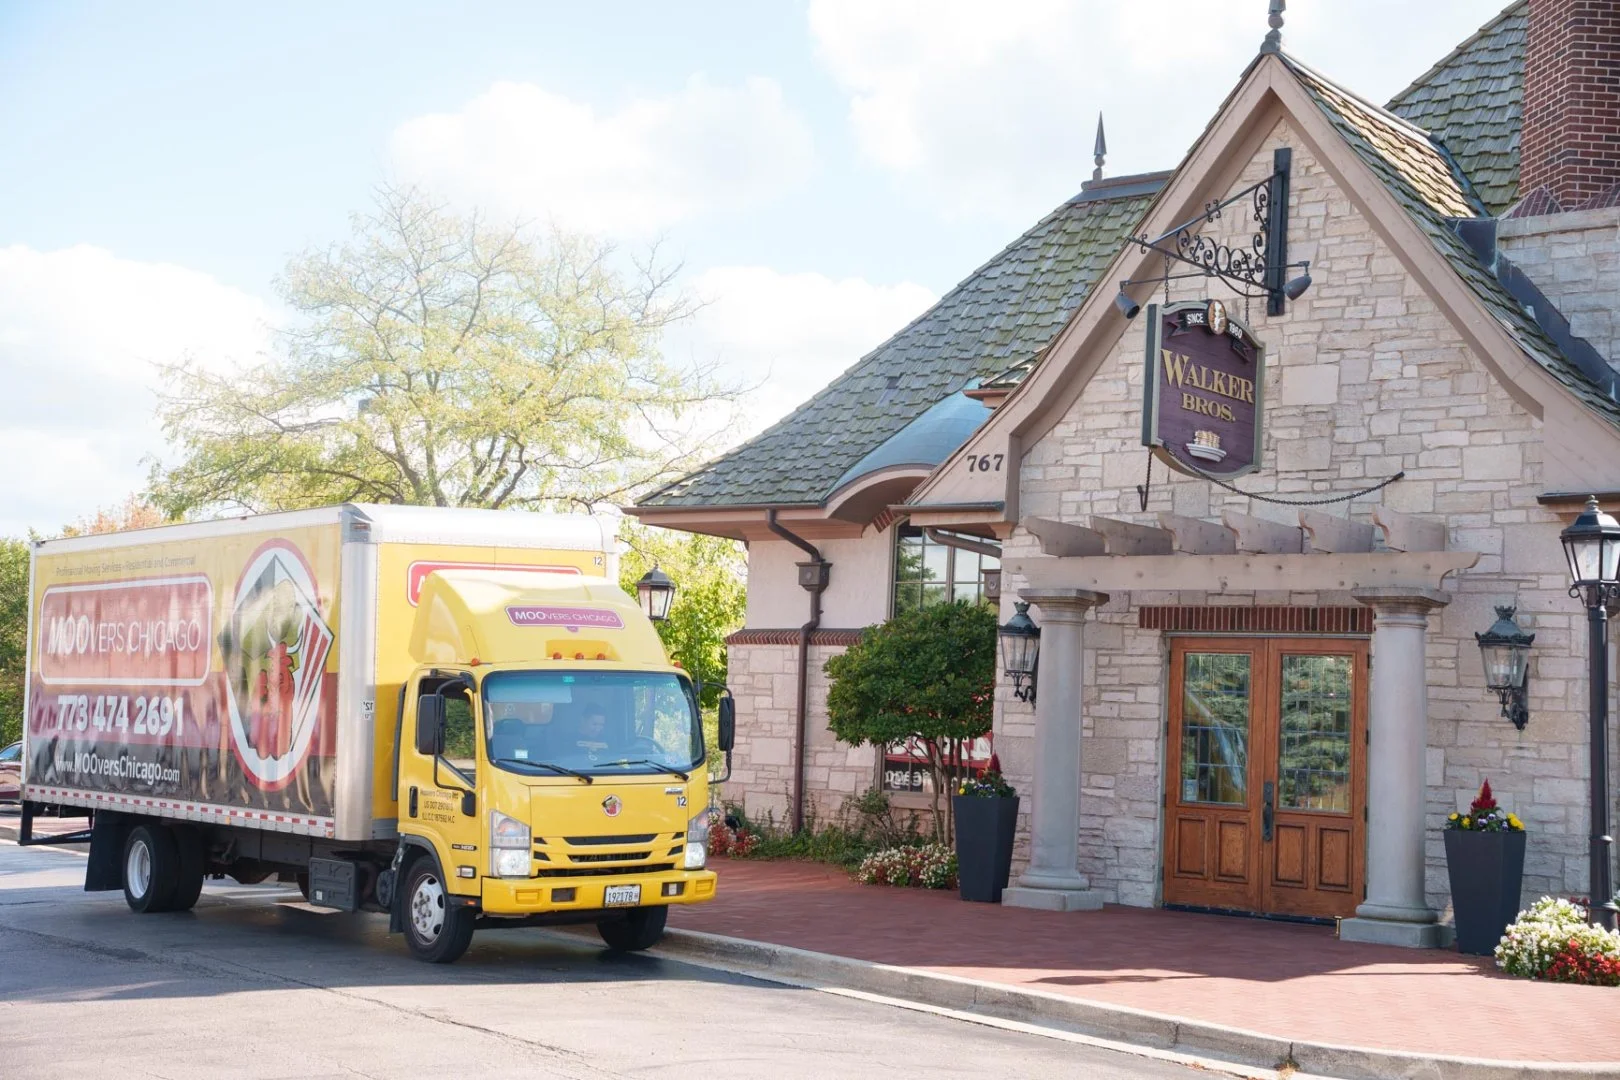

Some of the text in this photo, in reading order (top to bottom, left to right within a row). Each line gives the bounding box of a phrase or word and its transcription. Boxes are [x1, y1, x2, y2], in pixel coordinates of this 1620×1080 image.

[1186, 313, 1204, 325] SINCE
[1229, 322, 1243, 339] 1960
[1161, 349, 1255, 404] WALKER
[1181, 392, 1236, 422] BROS.
[967, 454, 1004, 472] 767
[594, 556, 603, 565] 12
[572, 613, 617, 623] CHICAGO
[48, 615, 201, 655] MOOVERS CHICAGO
[58, 695, 184, 737] 773 474 2691
[56, 752, 180, 785] www.MOOversChicago.com
[677, 796, 687, 807] 12
